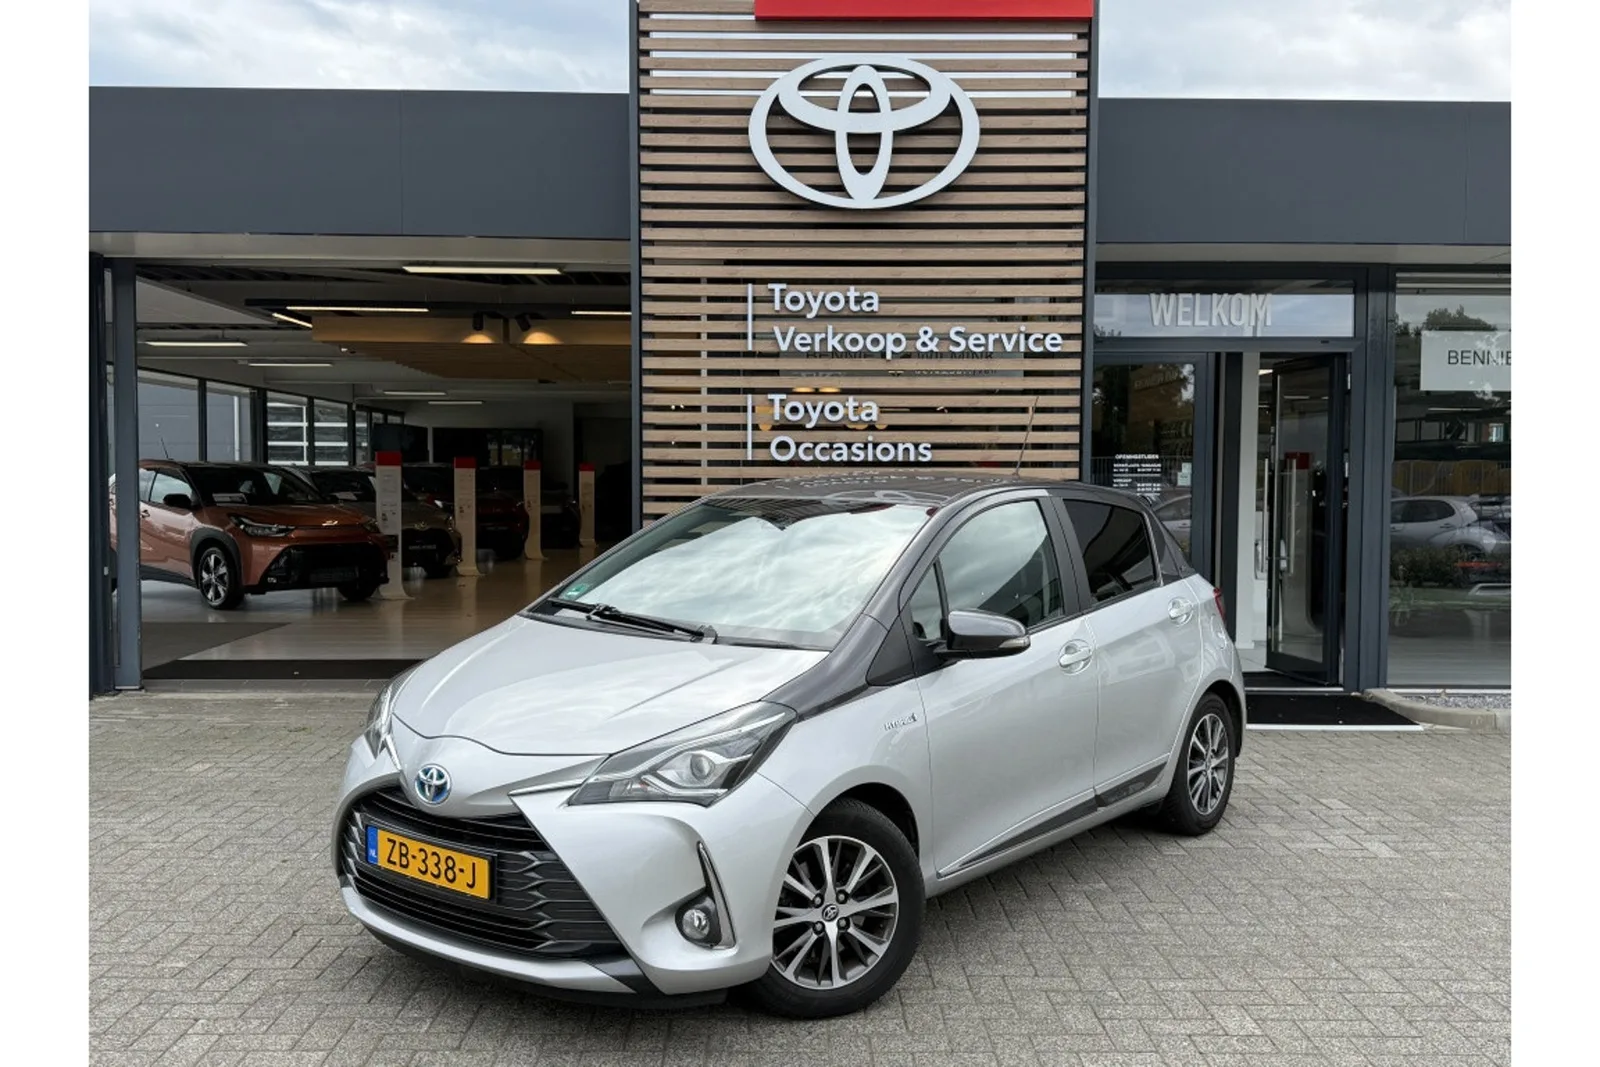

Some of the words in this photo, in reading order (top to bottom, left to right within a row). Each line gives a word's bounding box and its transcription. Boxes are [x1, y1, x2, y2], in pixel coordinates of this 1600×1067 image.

[767, 283, 879, 318] Toyota
[1149, 293, 1273, 326] WELKOM
[773, 325, 906, 360] Verkoop
[915, 326, 940, 352] &
[949, 325, 1064, 353] Service
[767, 393, 879, 428] Toyota
[769, 434, 932, 462] Occasions
[386, 837, 476, 889] ZB-338-J
